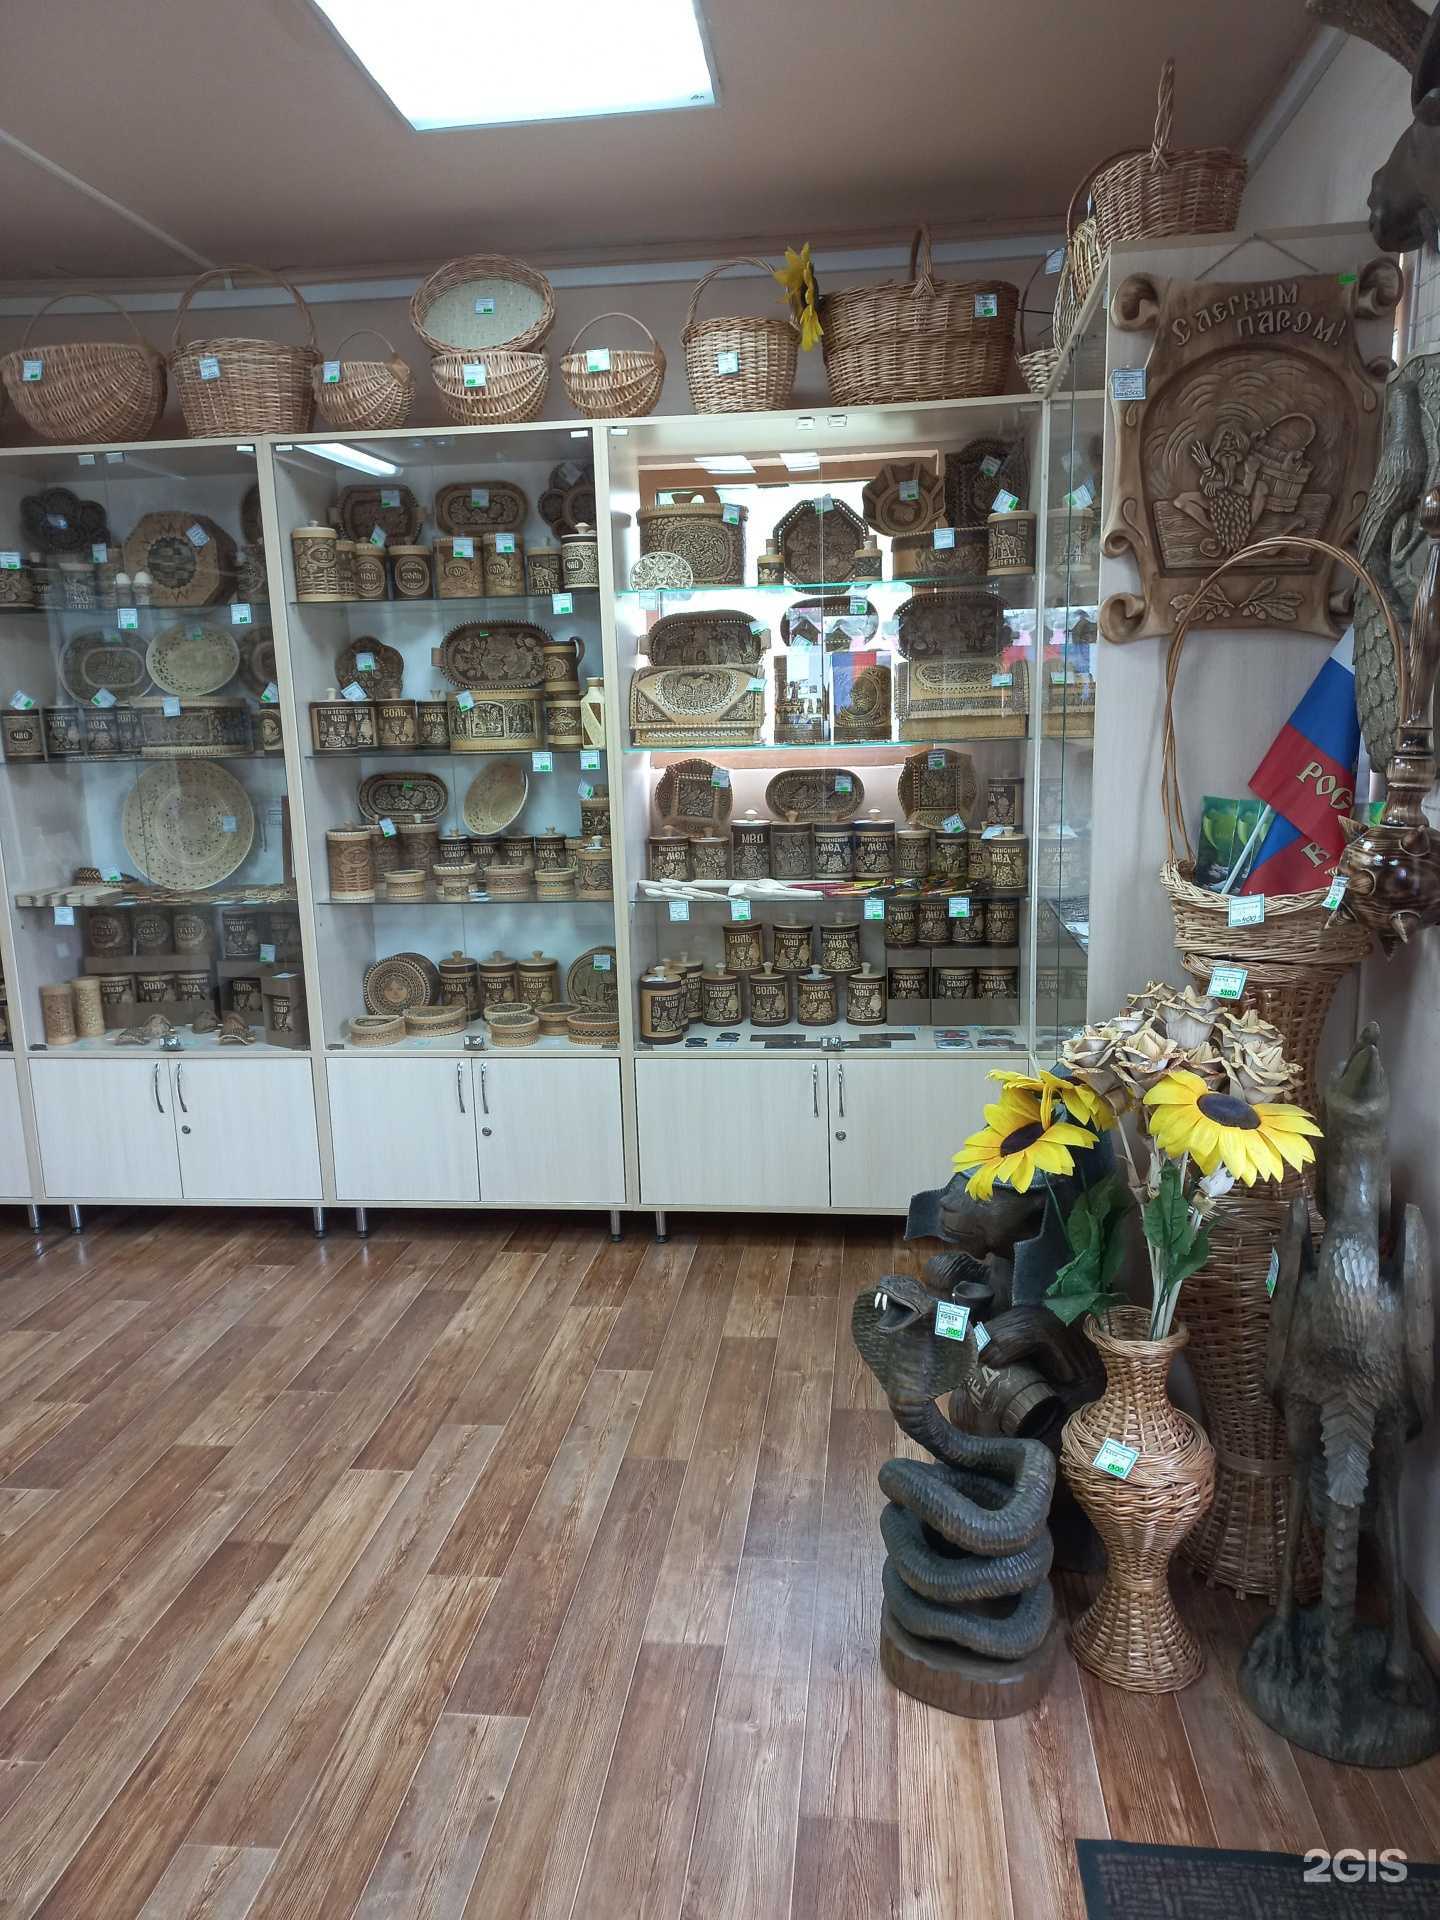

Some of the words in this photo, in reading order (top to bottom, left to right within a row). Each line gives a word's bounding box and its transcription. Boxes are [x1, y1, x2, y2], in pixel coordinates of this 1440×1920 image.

[1172, 318, 1191, 346] С
[1195, 283, 1298, 332] ЛЕГКИМ
[1236, 309, 1347, 346] ПАРОМ!
